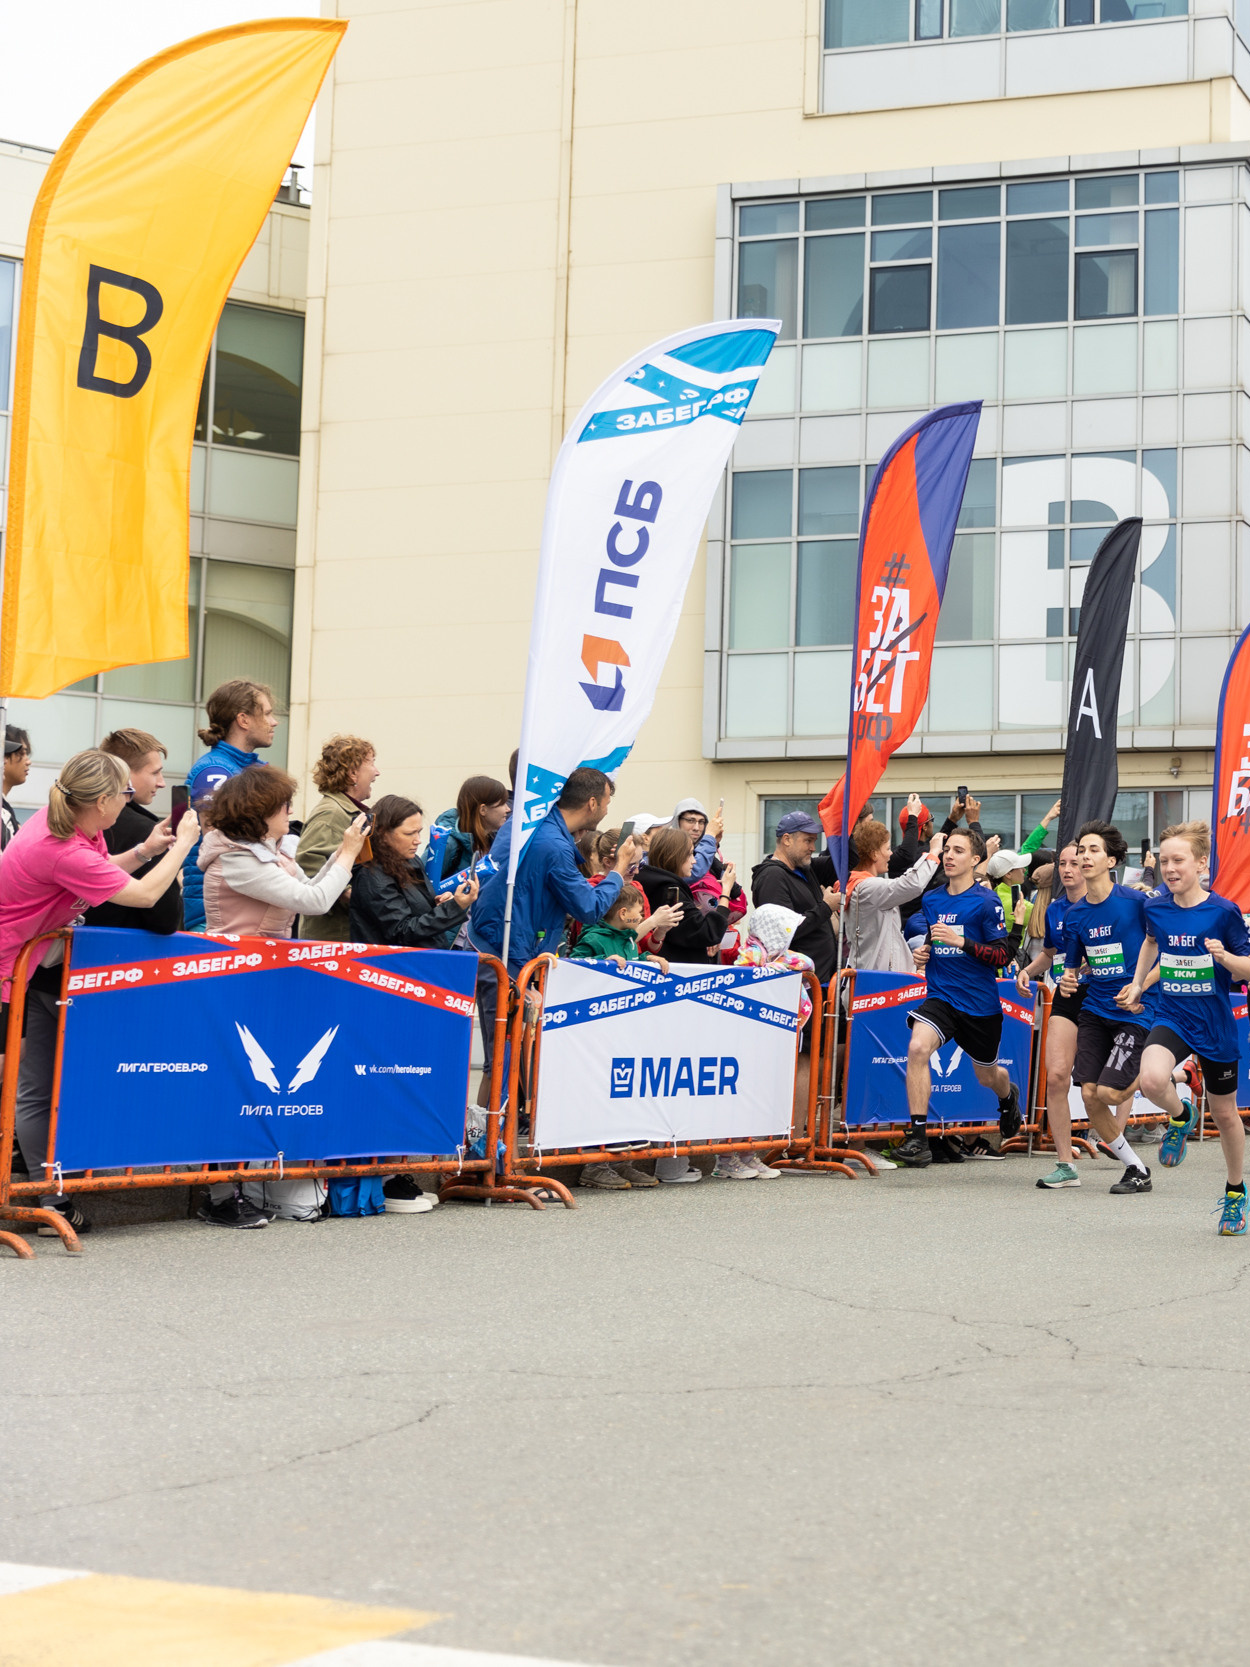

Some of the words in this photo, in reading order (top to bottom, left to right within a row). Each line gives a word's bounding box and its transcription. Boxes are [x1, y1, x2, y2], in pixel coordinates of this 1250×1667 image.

[594, 479, 663, 620] ПСБ
[869, 586, 911, 651] ЗА
[854, 650, 920, 713] БЕГ
[67, 968, 143, 991] БЕГ.РФ
[172, 953, 263, 977] ЗАБЕГ.РФ
[288, 943, 368, 962] ЗАБЕГ.РФ
[616, 964, 673, 985] ЗАБЕГ.Р
[358, 969, 426, 998] ЗАБЕГ.РФ
[588, 990, 657, 1017] ЗАБЕГ.РФ
[674, 973, 736, 997] ЗАБЕГ.РФ
[1162, 982, 1212, 993] 20265
[852, 995, 886, 1011] БЕГ.РФ
[117, 1063, 208, 1073] ЛИГАГЕРОЕВ.РФ
[369, 1063, 432, 1076] vk.com/heroleague
[639, 1056, 740, 1098] MAER
[940, 1084, 962, 1093] ГЕРОЕВ
[240, 1105, 273, 1116] ЛИГА
[277, 1105, 323, 1116] ГЕРОЕВ
